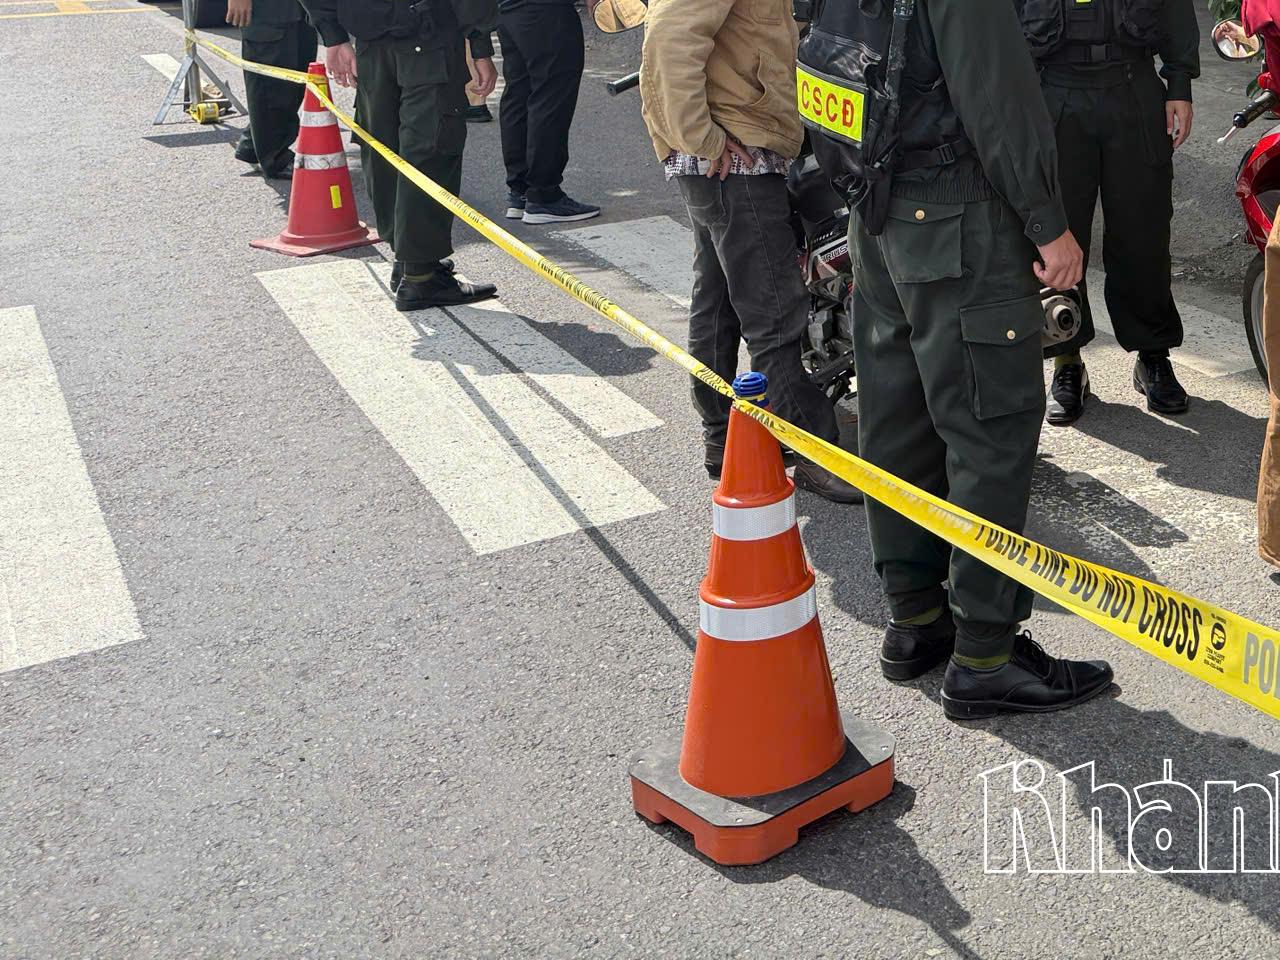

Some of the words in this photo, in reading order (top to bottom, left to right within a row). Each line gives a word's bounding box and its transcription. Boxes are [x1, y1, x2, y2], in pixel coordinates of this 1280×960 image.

[801, 80, 855, 128] CSCĐ
[1030, 546, 1070, 588] LINE
[1096, 569, 1136, 624] NOT
[1137, 585, 1204, 662] CROSS
